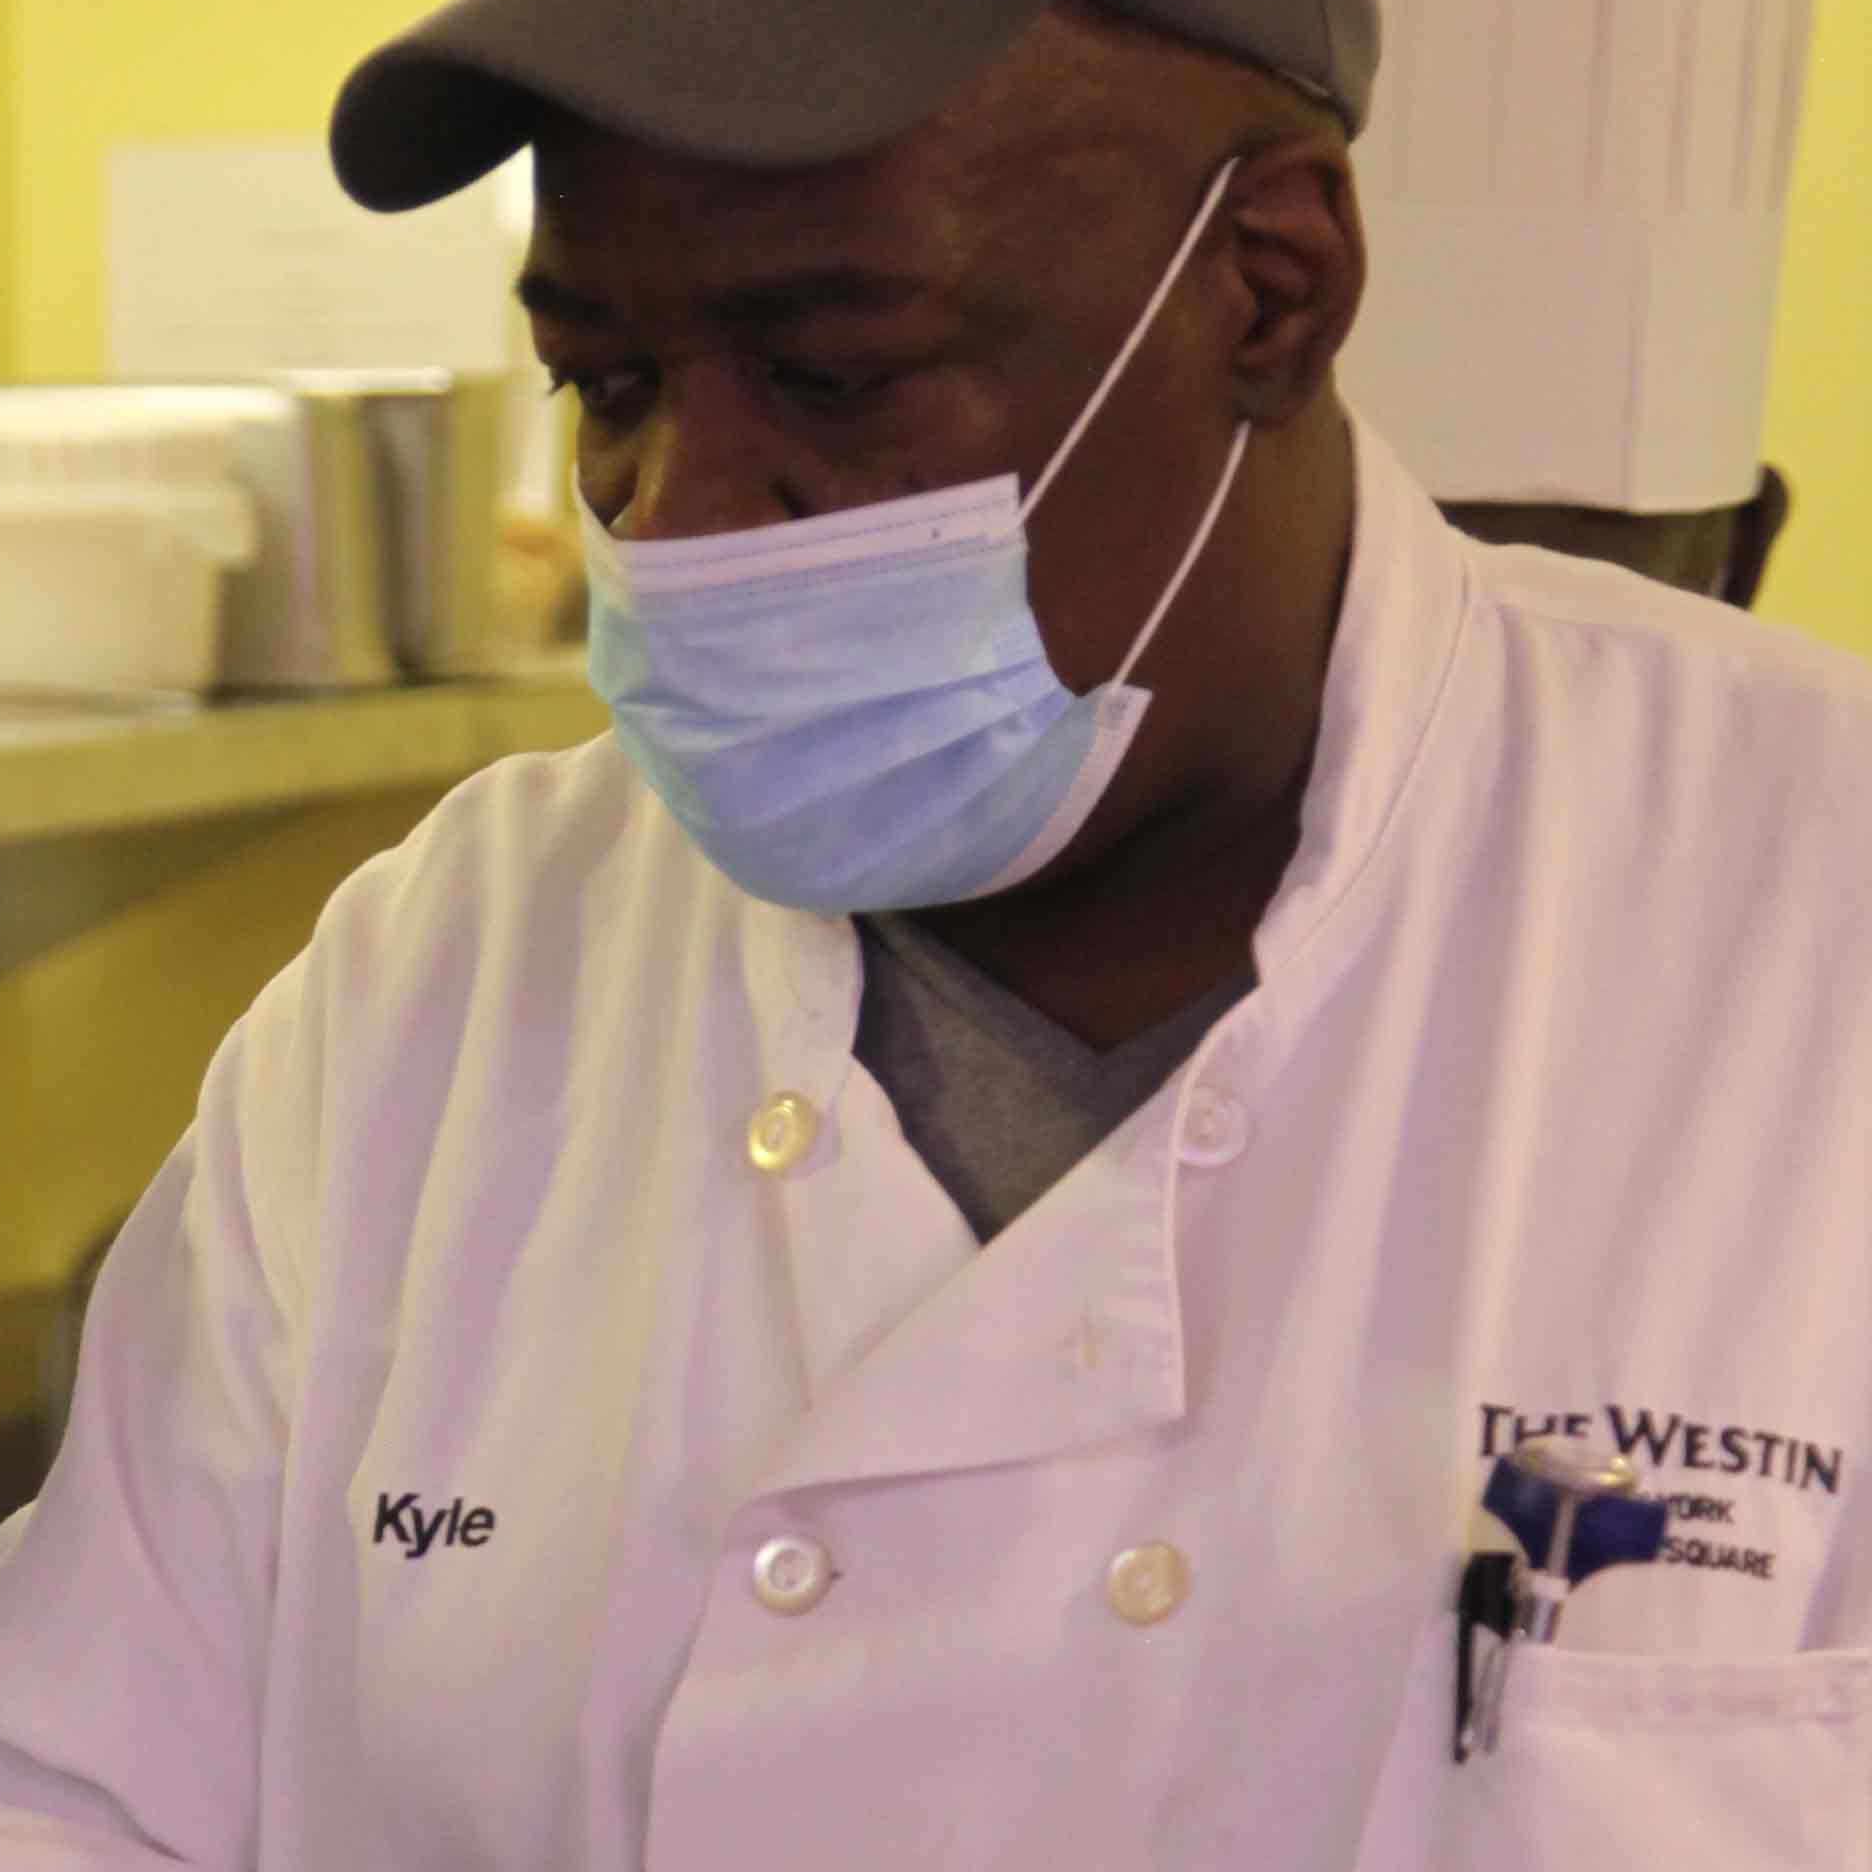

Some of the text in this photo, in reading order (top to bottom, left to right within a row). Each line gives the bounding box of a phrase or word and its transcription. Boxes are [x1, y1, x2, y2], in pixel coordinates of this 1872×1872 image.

[1604, 1403, 1843, 1495] WESTIN
[372, 1491, 497, 1560] Kyle
[1664, 1535, 1777, 1580] SQUARE
